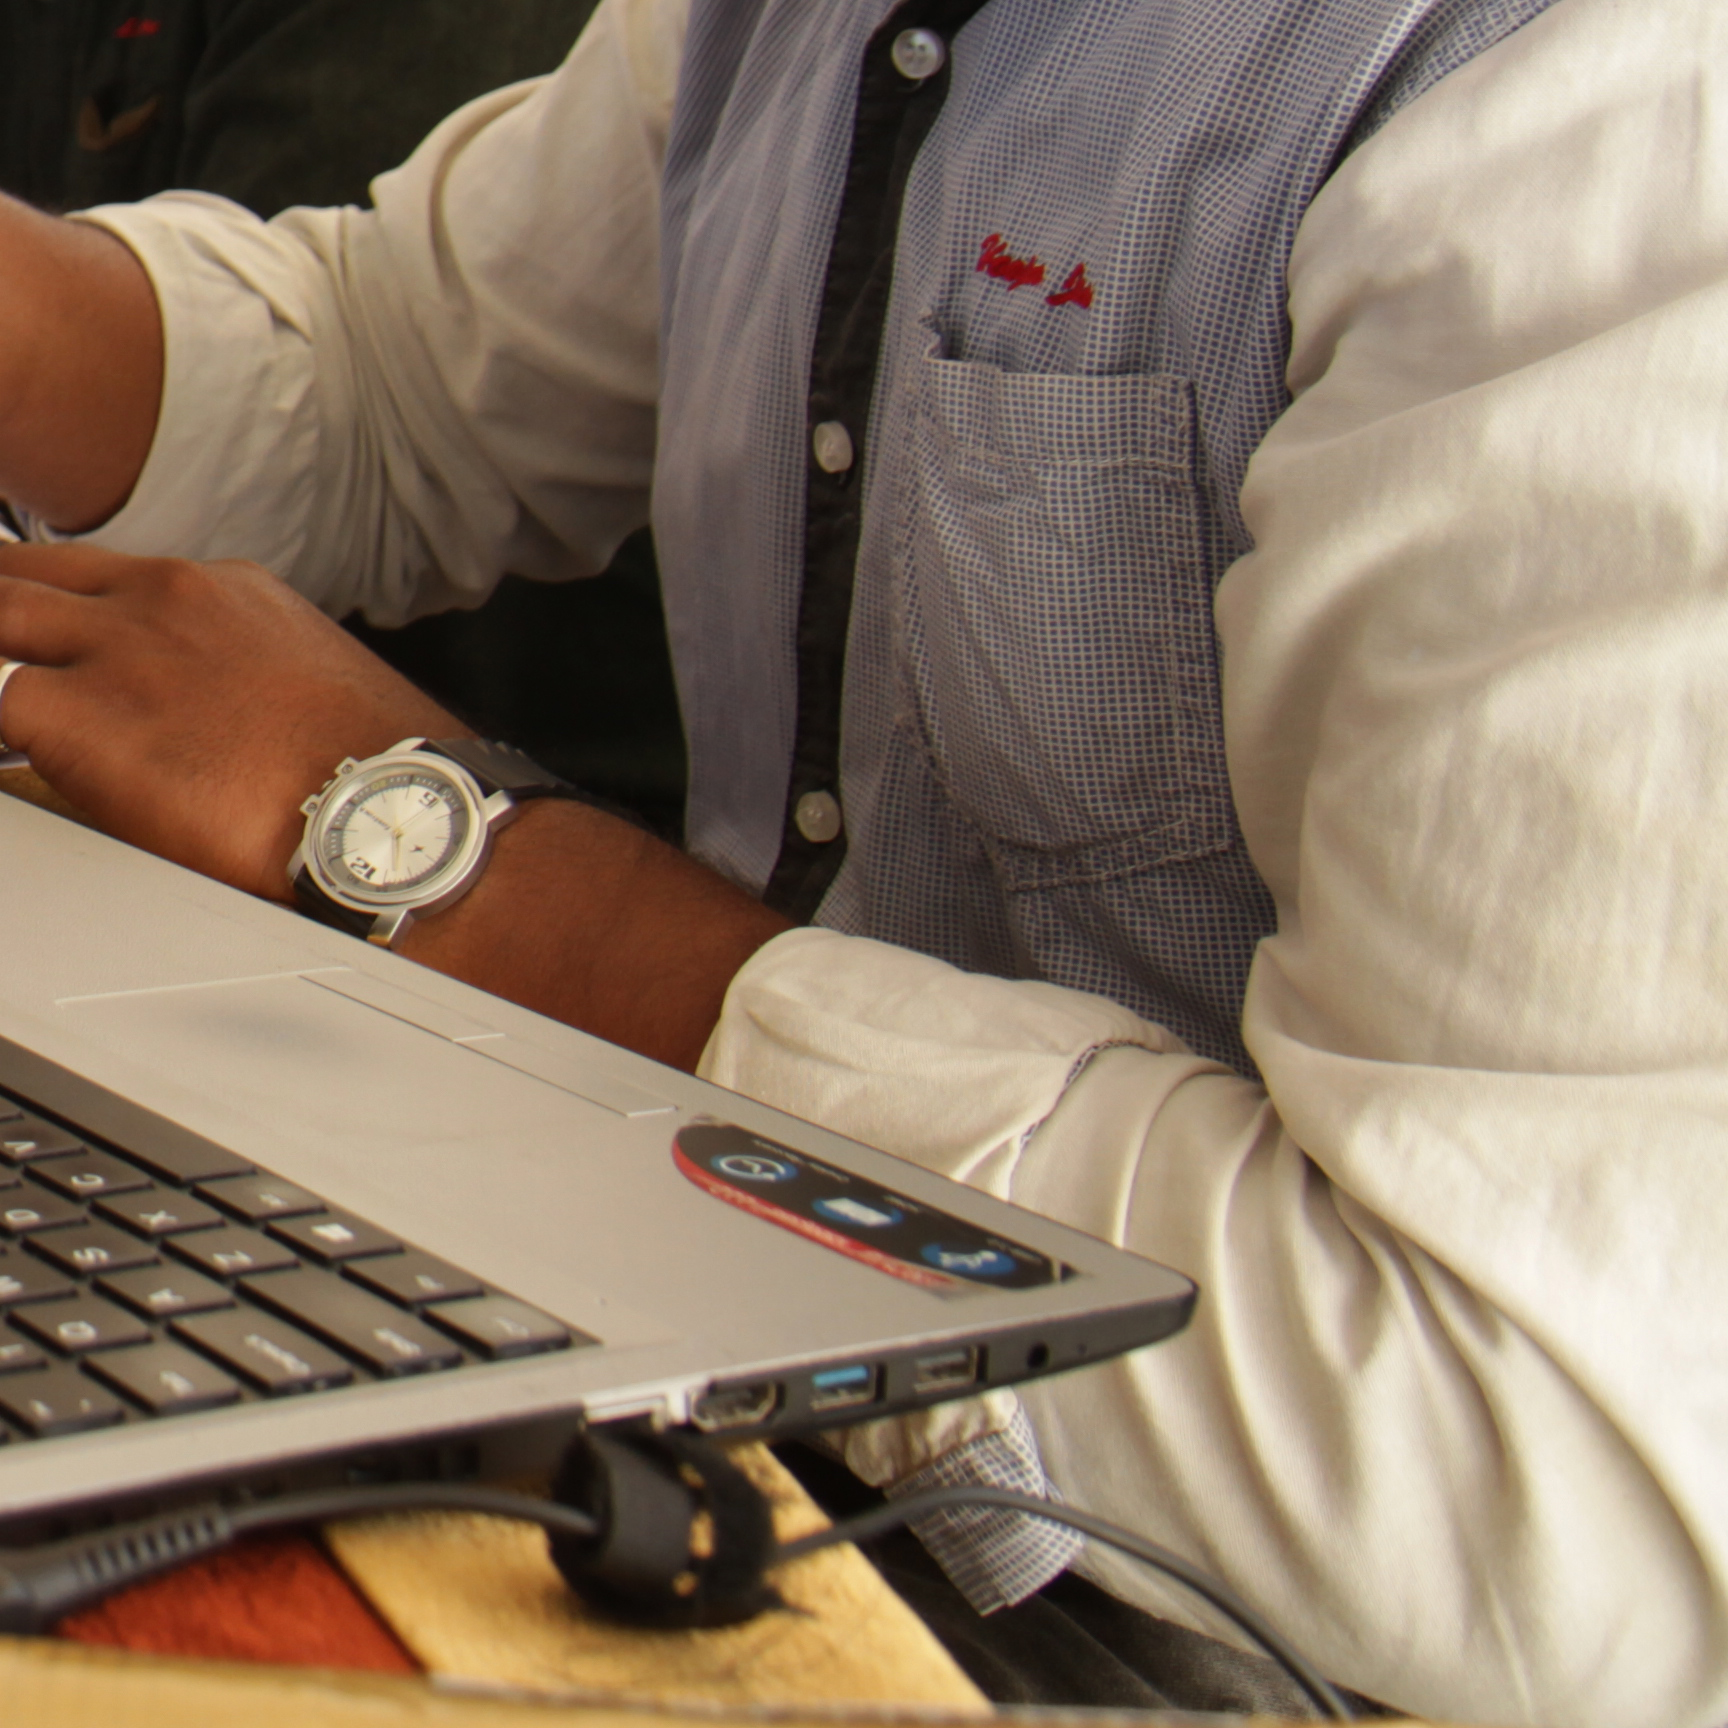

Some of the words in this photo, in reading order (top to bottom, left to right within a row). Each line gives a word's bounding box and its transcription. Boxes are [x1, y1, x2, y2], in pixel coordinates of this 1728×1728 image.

[349, 856, 378, 881] 12
[4, 1141, 38, 1154] V
[71, 1174, 104, 1189] C
[139, 1210, 178, 1227] X
[5, 1209, 40, 1224] D
[72, 1247, 110, 1266] S
